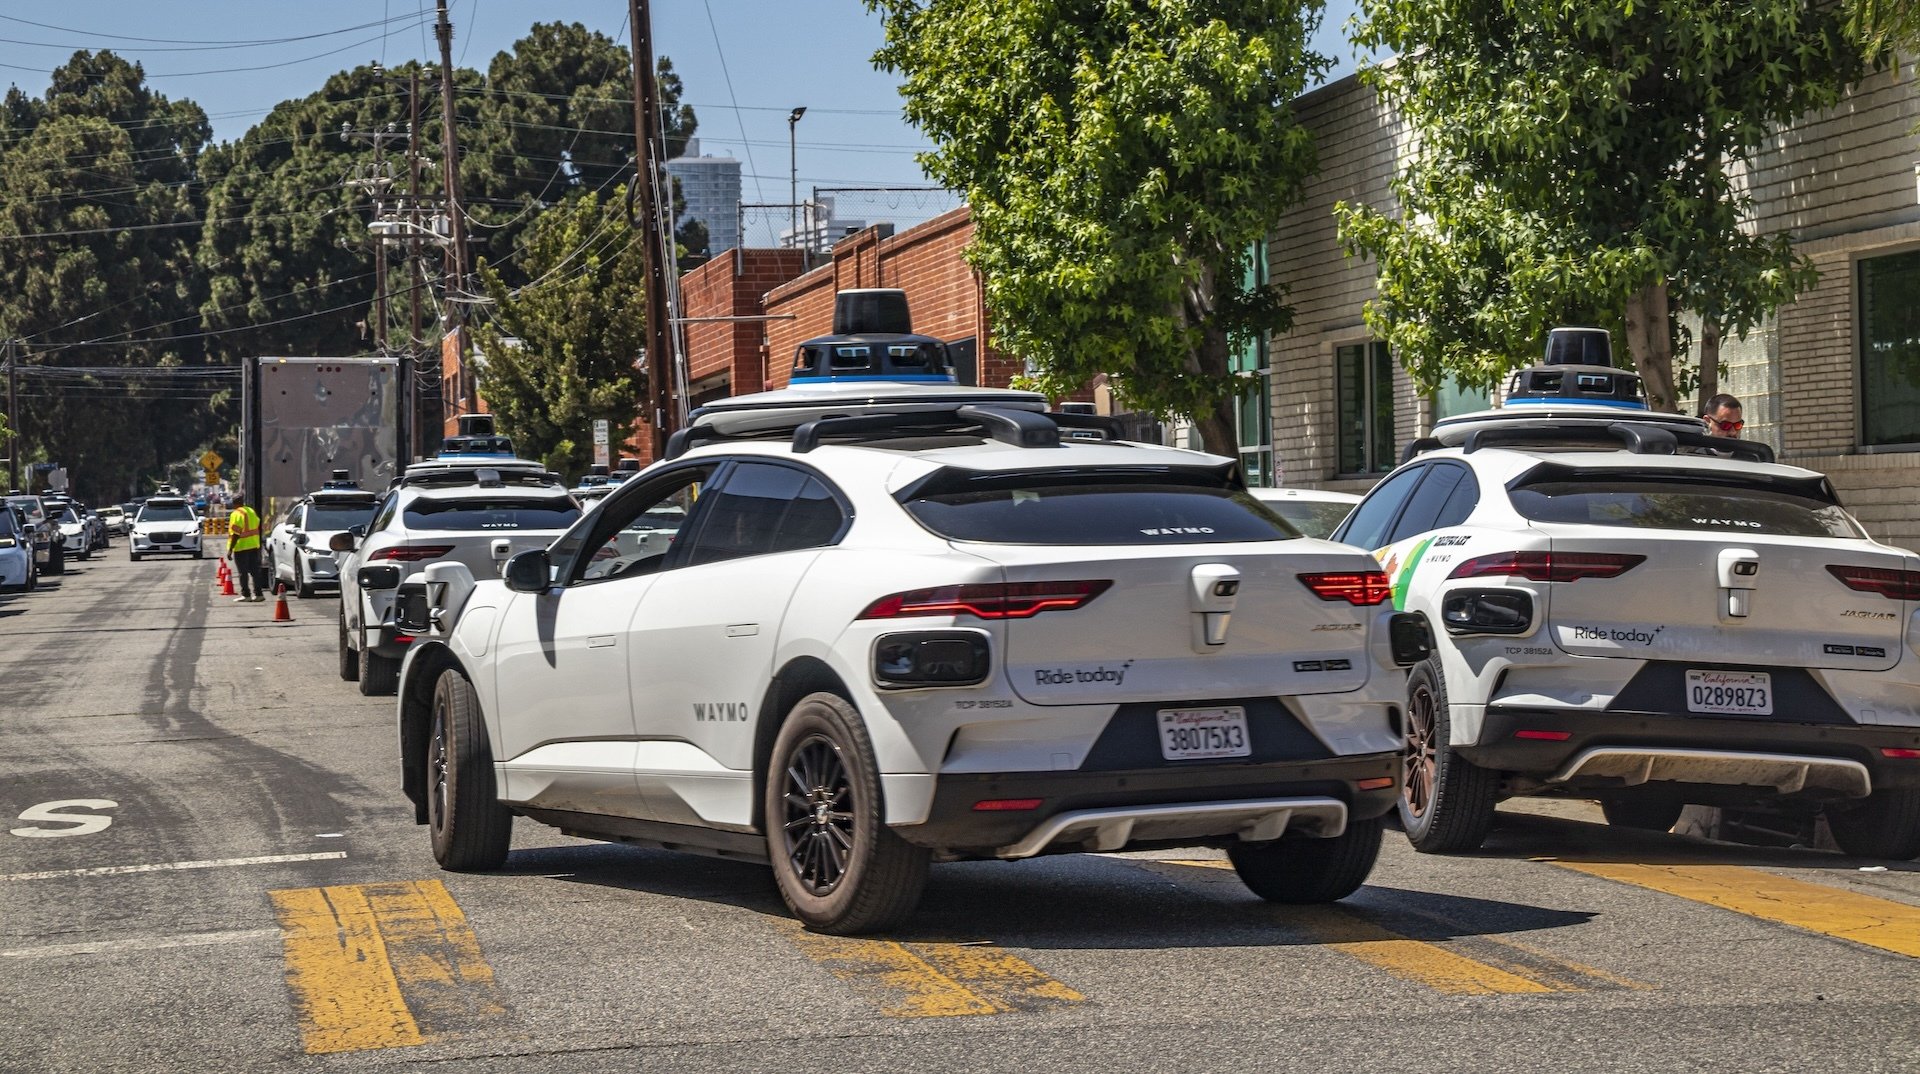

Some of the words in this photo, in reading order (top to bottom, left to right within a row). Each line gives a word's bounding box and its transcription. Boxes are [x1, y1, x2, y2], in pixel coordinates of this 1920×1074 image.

[1691, 518, 1762, 528] WAYMO
[1140, 527, 1215, 536] WAYMO
[1840, 610, 1896, 619] JAGUAR
[1575, 626, 1608, 640] Ride
[1610, 628, 1655, 645] today
[1505, 647, 1521, 655] TCP
[1523, 647, 1553, 655] 38152A
[1034, 669, 1073, 685] Ride
[1075, 666, 1125, 685] today
[1703, 673, 1752, 685] California
[1693, 686, 1767, 708] 02898Z3
[692, 702, 748, 722] WAYMO
[955, 701, 976, 709] TCP
[1166, 725, 1245, 751] 38075X3
[10, 798, 119, 838] S
